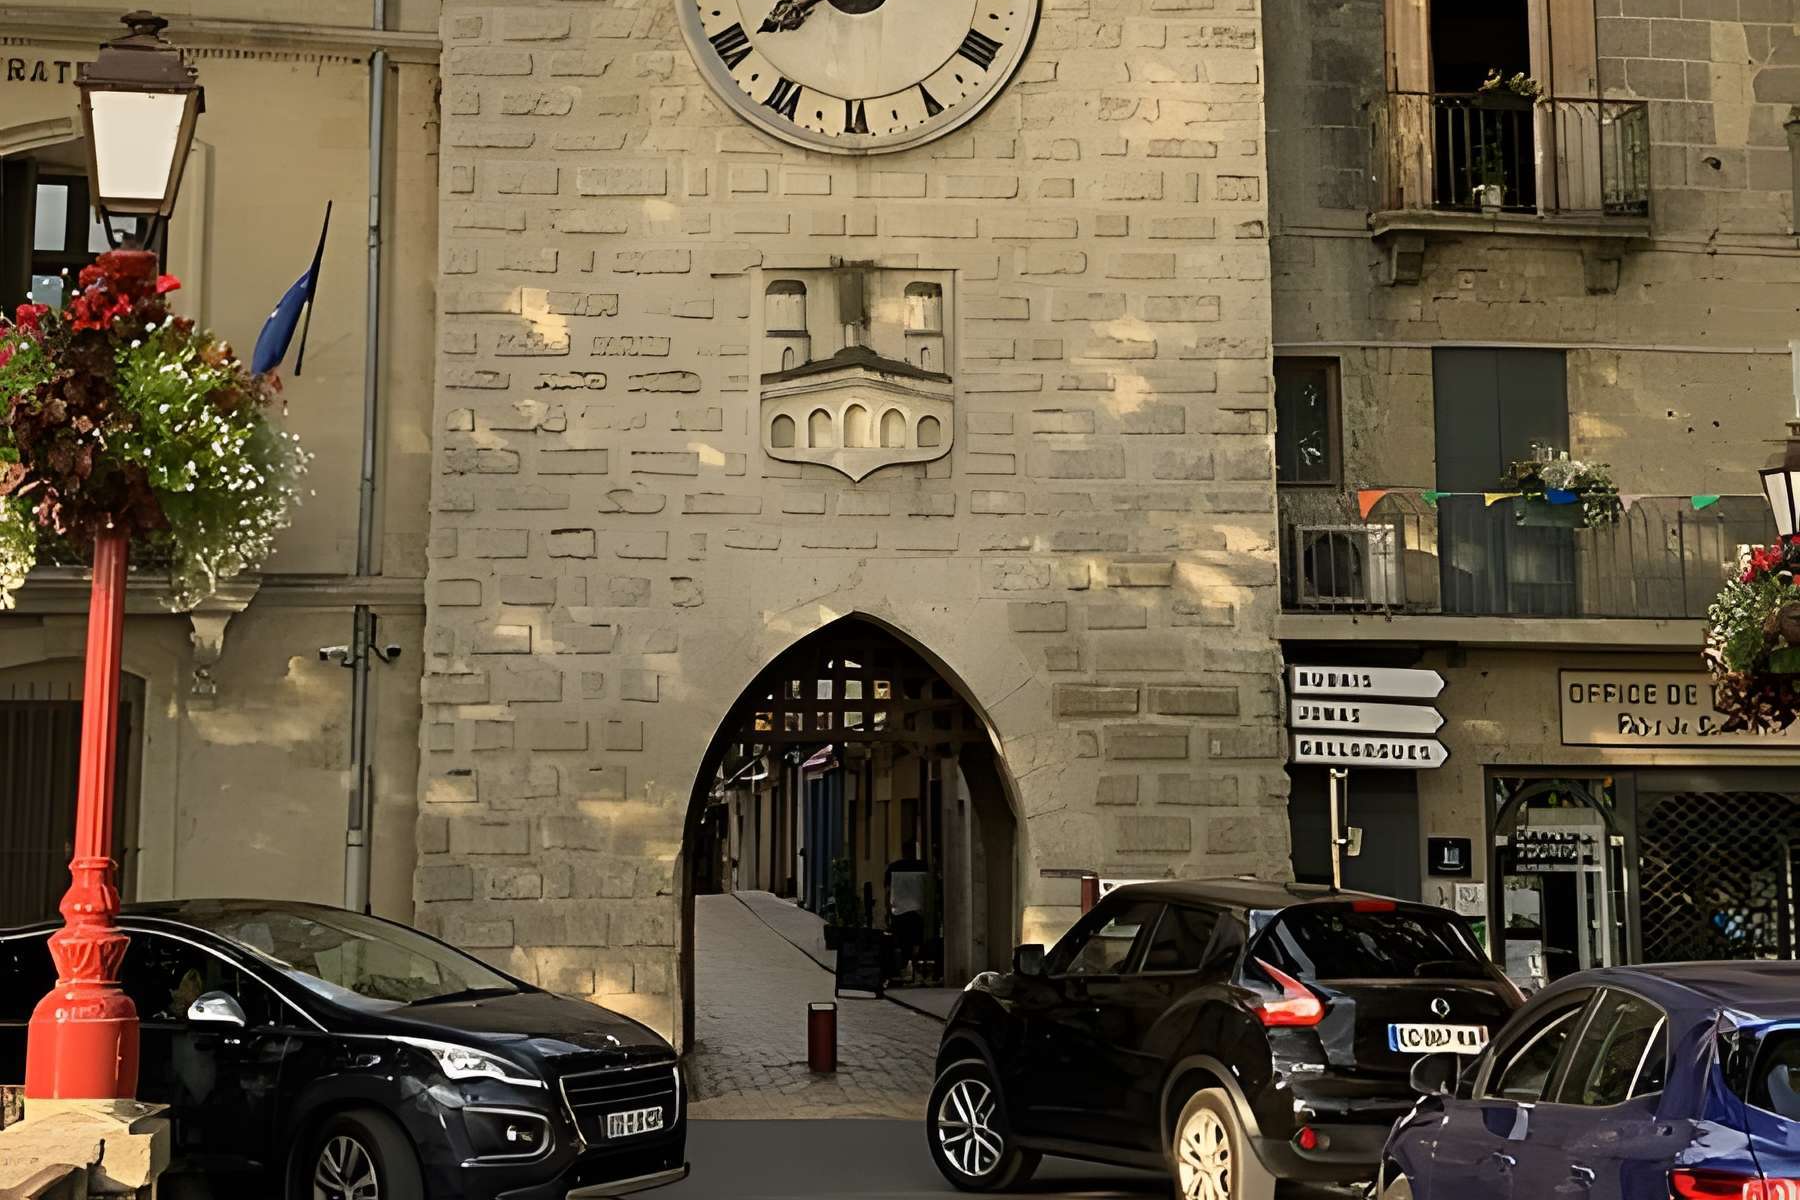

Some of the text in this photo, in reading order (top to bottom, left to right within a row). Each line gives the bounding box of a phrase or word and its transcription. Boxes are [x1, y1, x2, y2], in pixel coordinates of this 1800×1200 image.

[1, 57, 73, 84] RAT
[762, 77, 803, 120] VII
[919, 83, 945, 118] V
[844, 99, 869, 134] VI
[1568, 682, 1657, 704] OFFICE
[1667, 684, 1698, 706] DE
